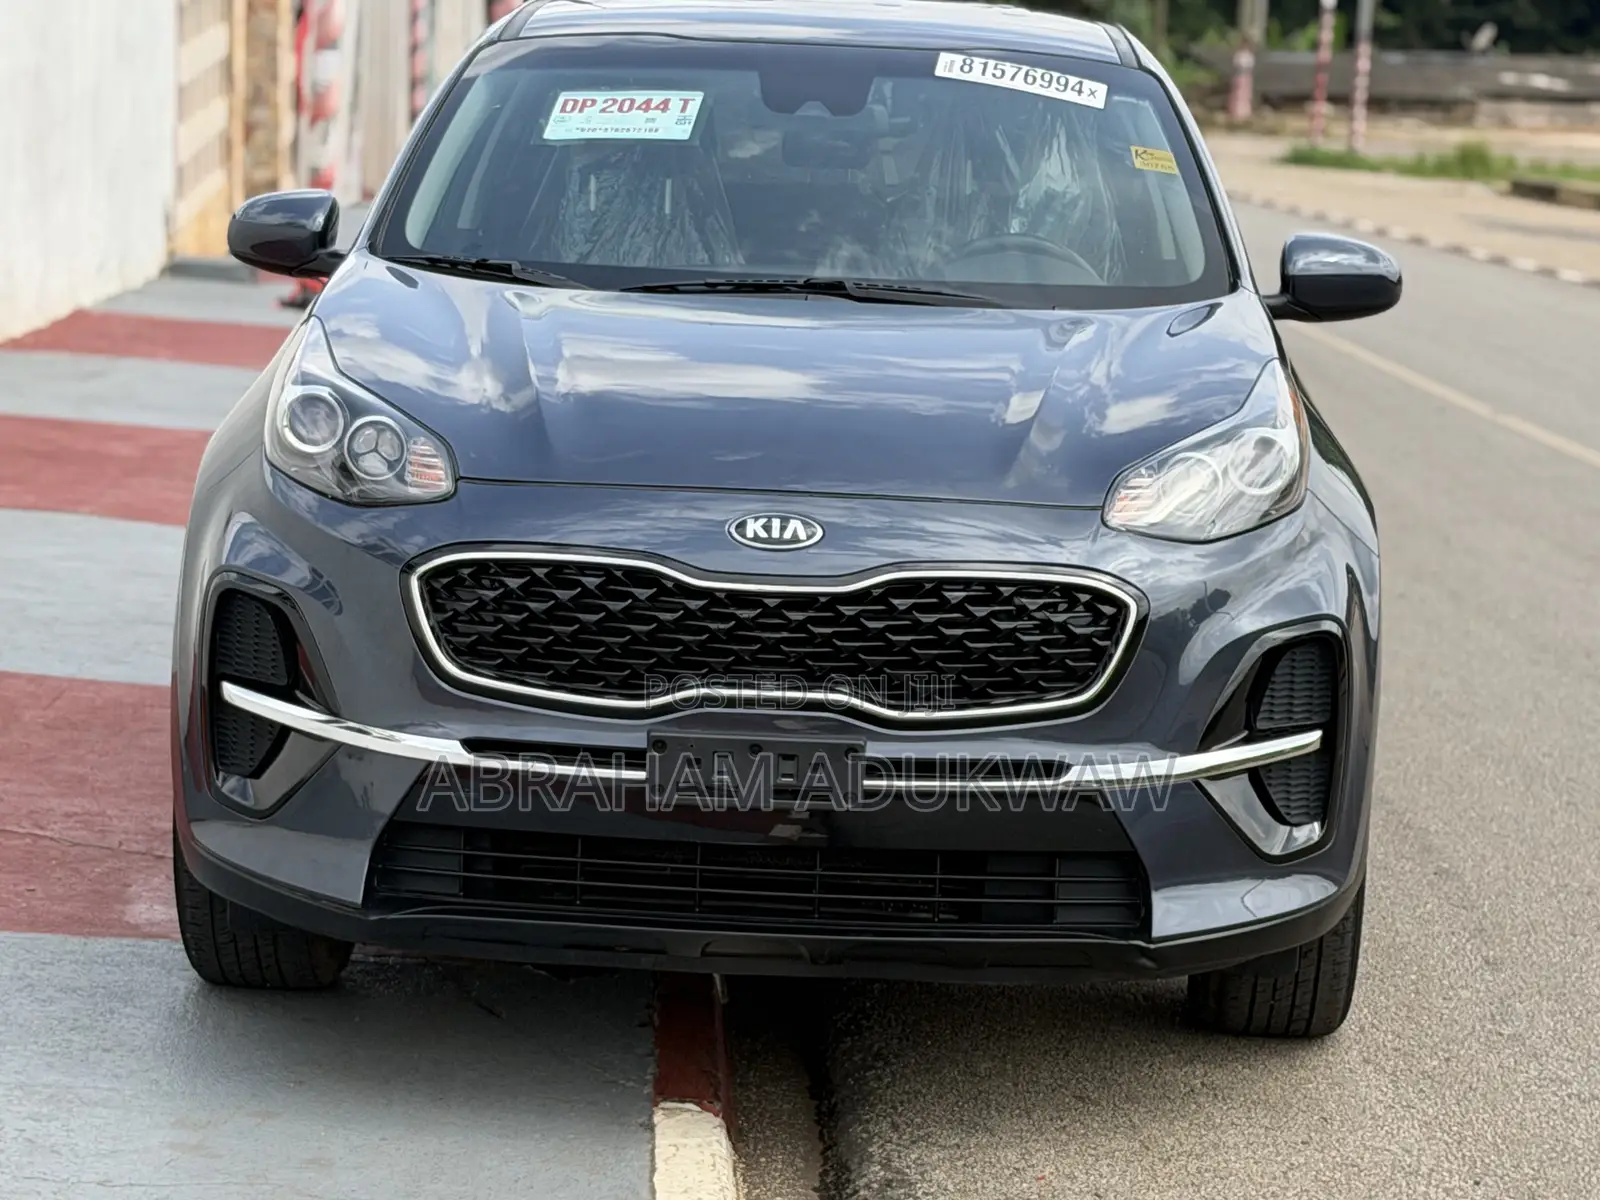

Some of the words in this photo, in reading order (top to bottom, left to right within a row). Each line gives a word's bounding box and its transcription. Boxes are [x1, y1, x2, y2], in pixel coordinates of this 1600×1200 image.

[560, 97, 597, 114] DP
[598, 97, 671, 114] 2044
[679, 97, 696, 114] T
[745, 517, 808, 541] KIA
